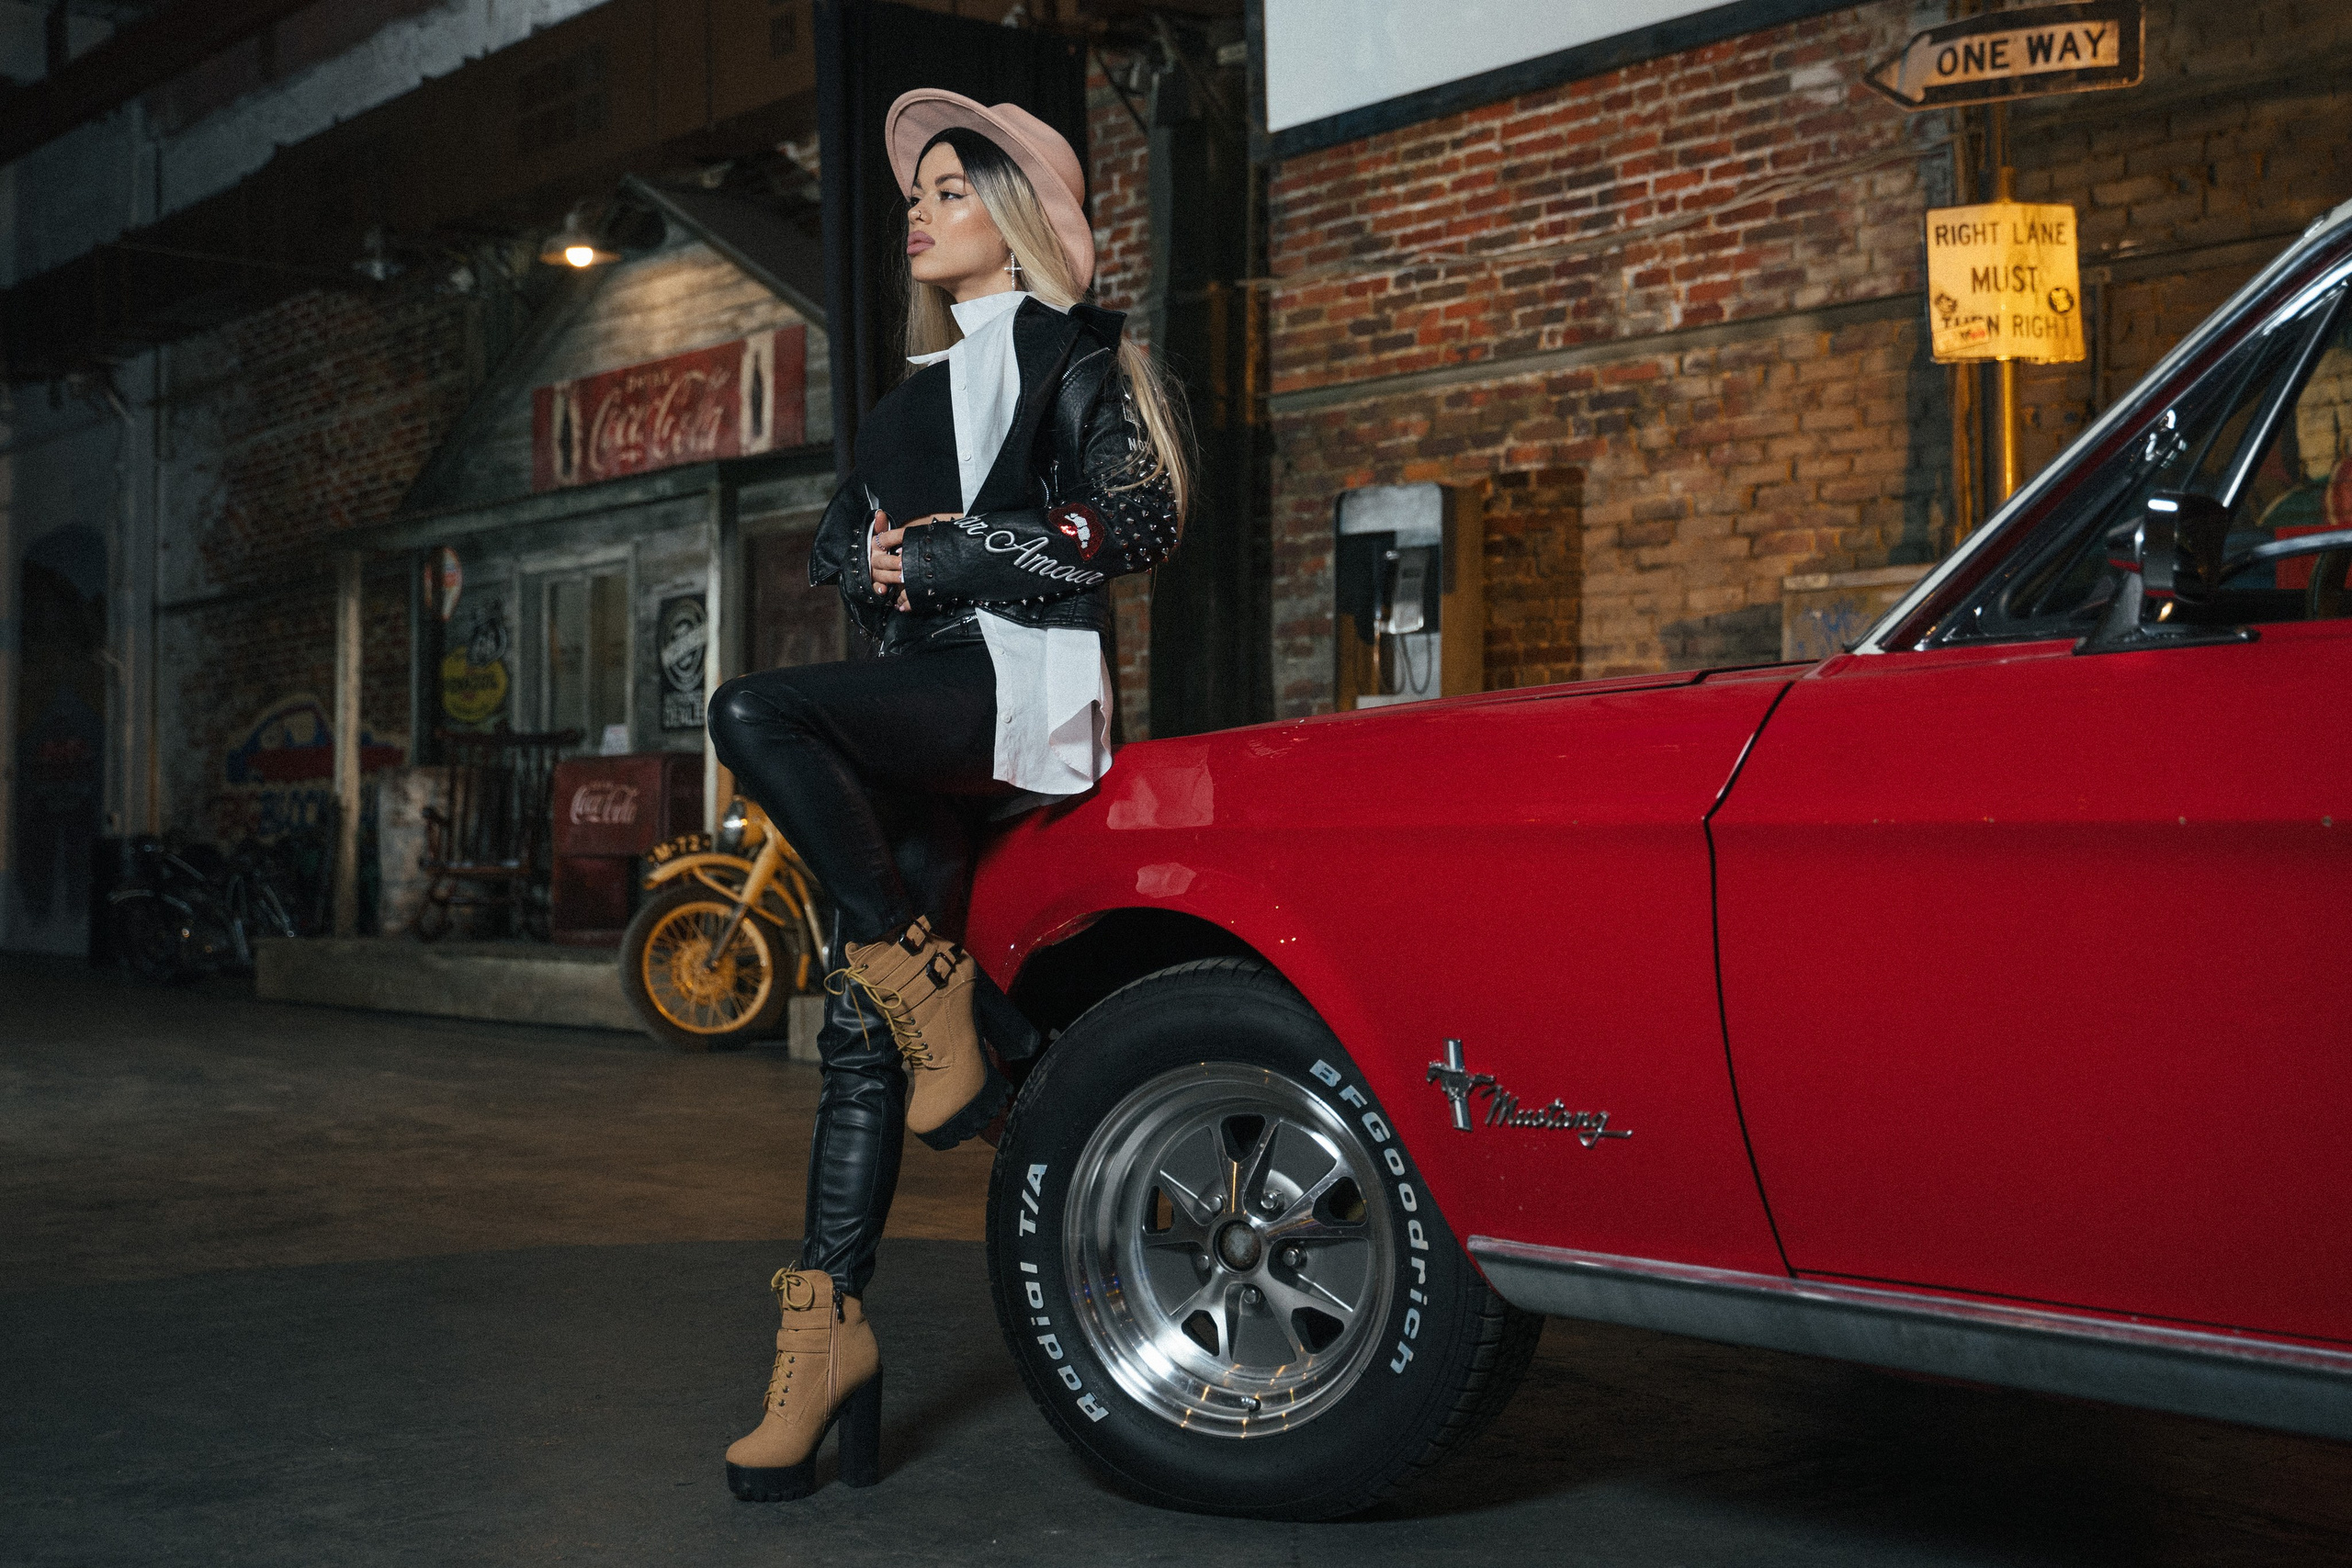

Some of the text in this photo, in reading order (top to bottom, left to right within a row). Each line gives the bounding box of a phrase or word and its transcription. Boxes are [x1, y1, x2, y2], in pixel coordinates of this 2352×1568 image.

[1937, 28, 2106, 76] ONE WAY
[1934, 219, 2067, 247] RIGHT LANE
[1971, 265, 2038, 294] MUST
[1942, 314, 2000, 337] TN
[2012, 314, 2072, 339] RIGHT
[984, 530, 1103, 585] Amour
[1479, 1084, 1633, 1149] Mustang
[1309, 1059, 1429, 1374] BFGoodrich
[1019, 1164, 1110, 1423] Radial T/A
